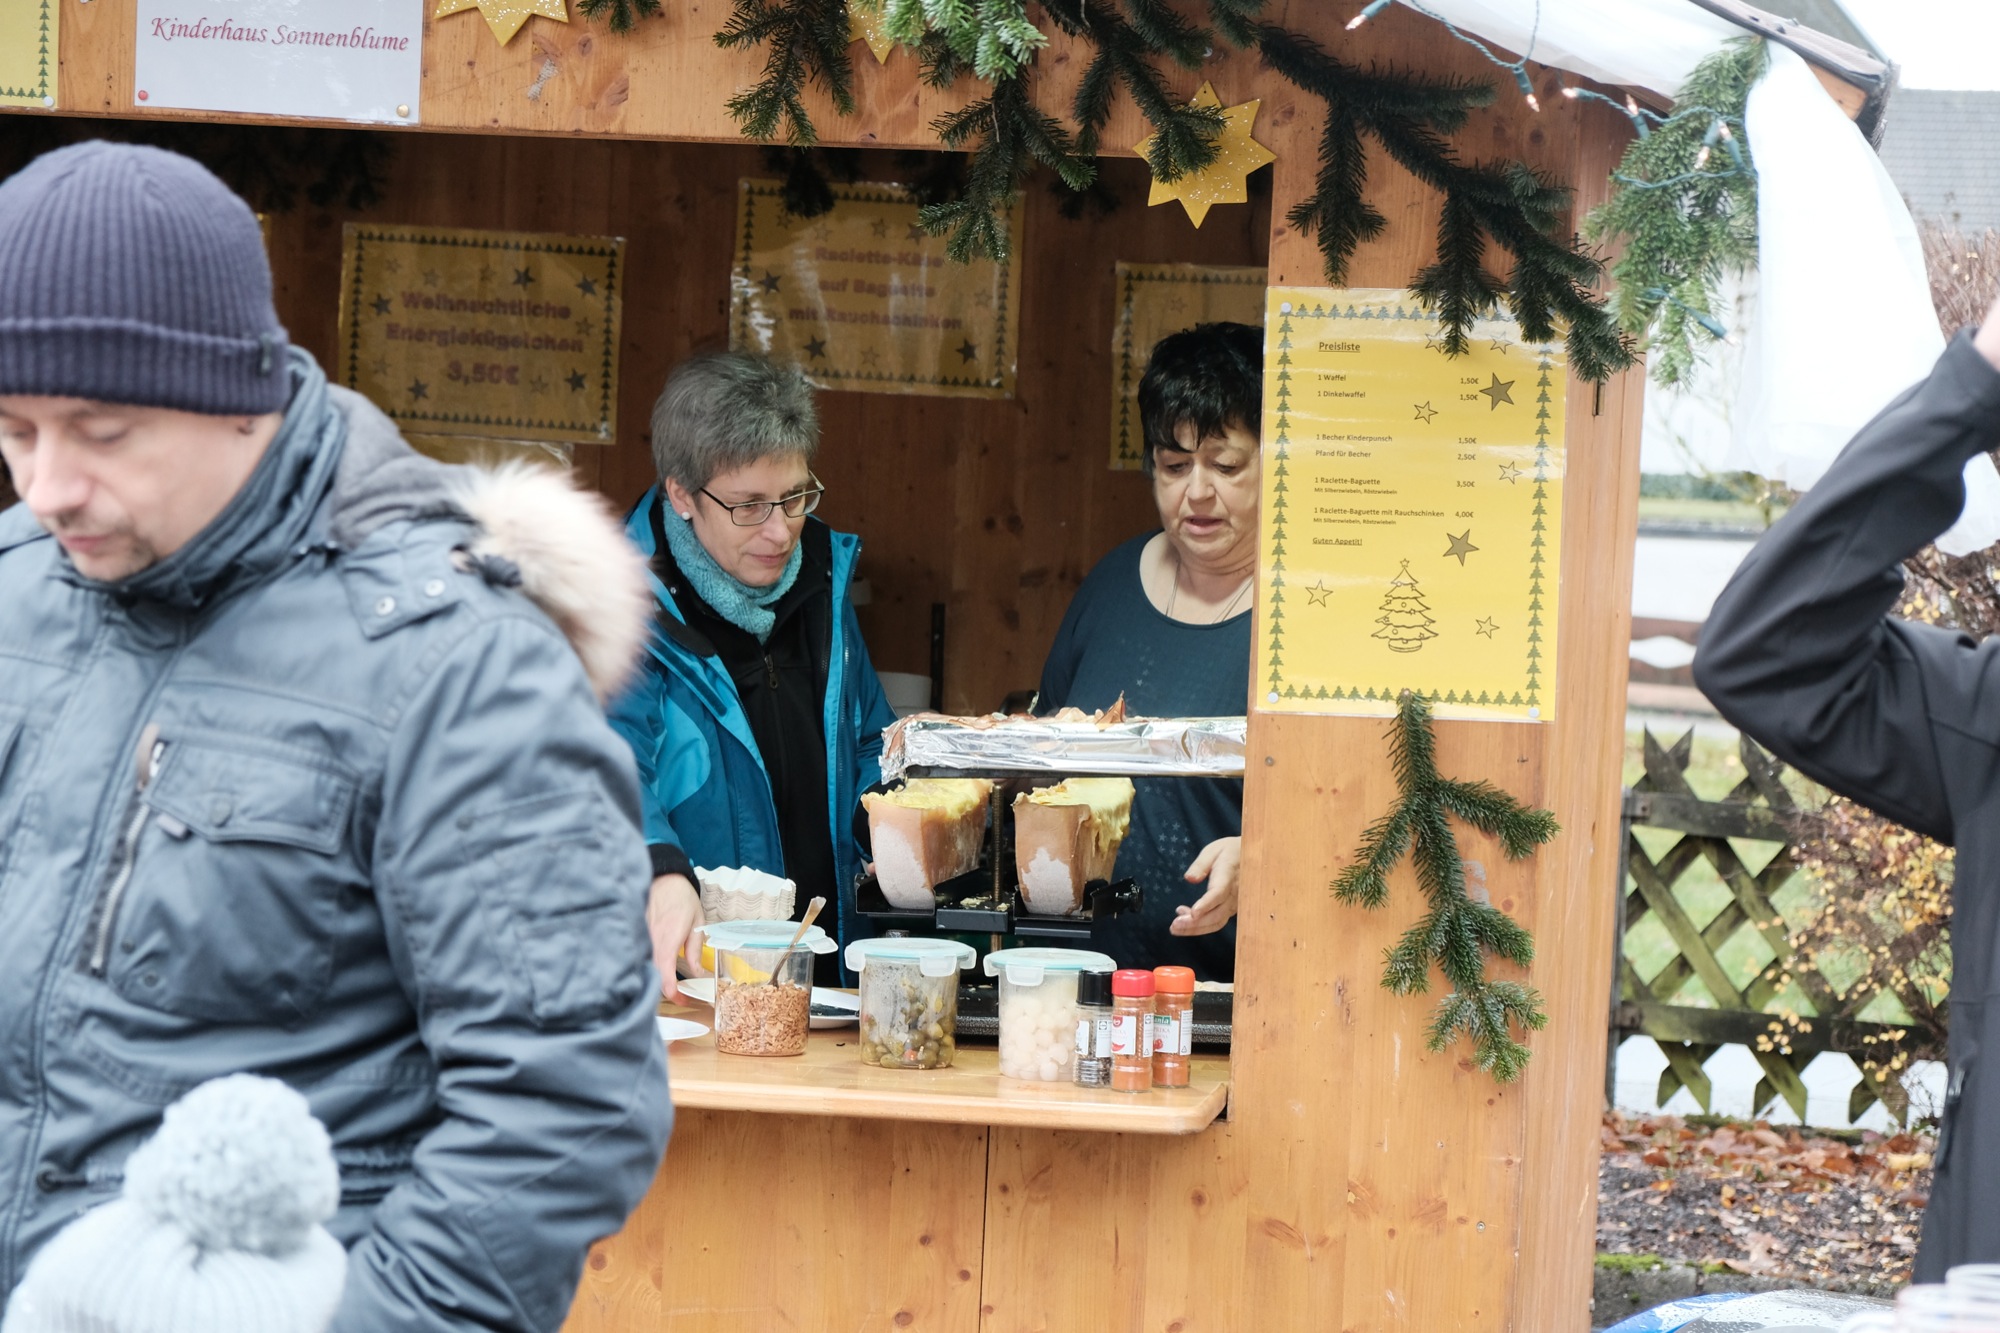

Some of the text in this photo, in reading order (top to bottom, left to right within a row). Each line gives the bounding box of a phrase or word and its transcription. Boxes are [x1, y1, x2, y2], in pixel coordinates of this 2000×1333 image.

[151, 16, 410, 51] Kinderhaus Sonnenblume
[789, 308, 818, 321] mit
[1319, 341, 1361, 353] Preisliste
[447, 360, 520, 386] 3,50€
[1460, 377, 1479, 385] 1,50€
[1323, 390, 1366, 398] Dinkelwaffel
[1346, 435, 1392, 443] Kinderpunsch
[1458, 437, 1477, 445] 1,50€
[1320, 477, 1381, 486] Raclette-Baguette
[1320, 507, 1380, 516] Raclette-Baguette
[1455, 511, 1474, 519] 4,00€
